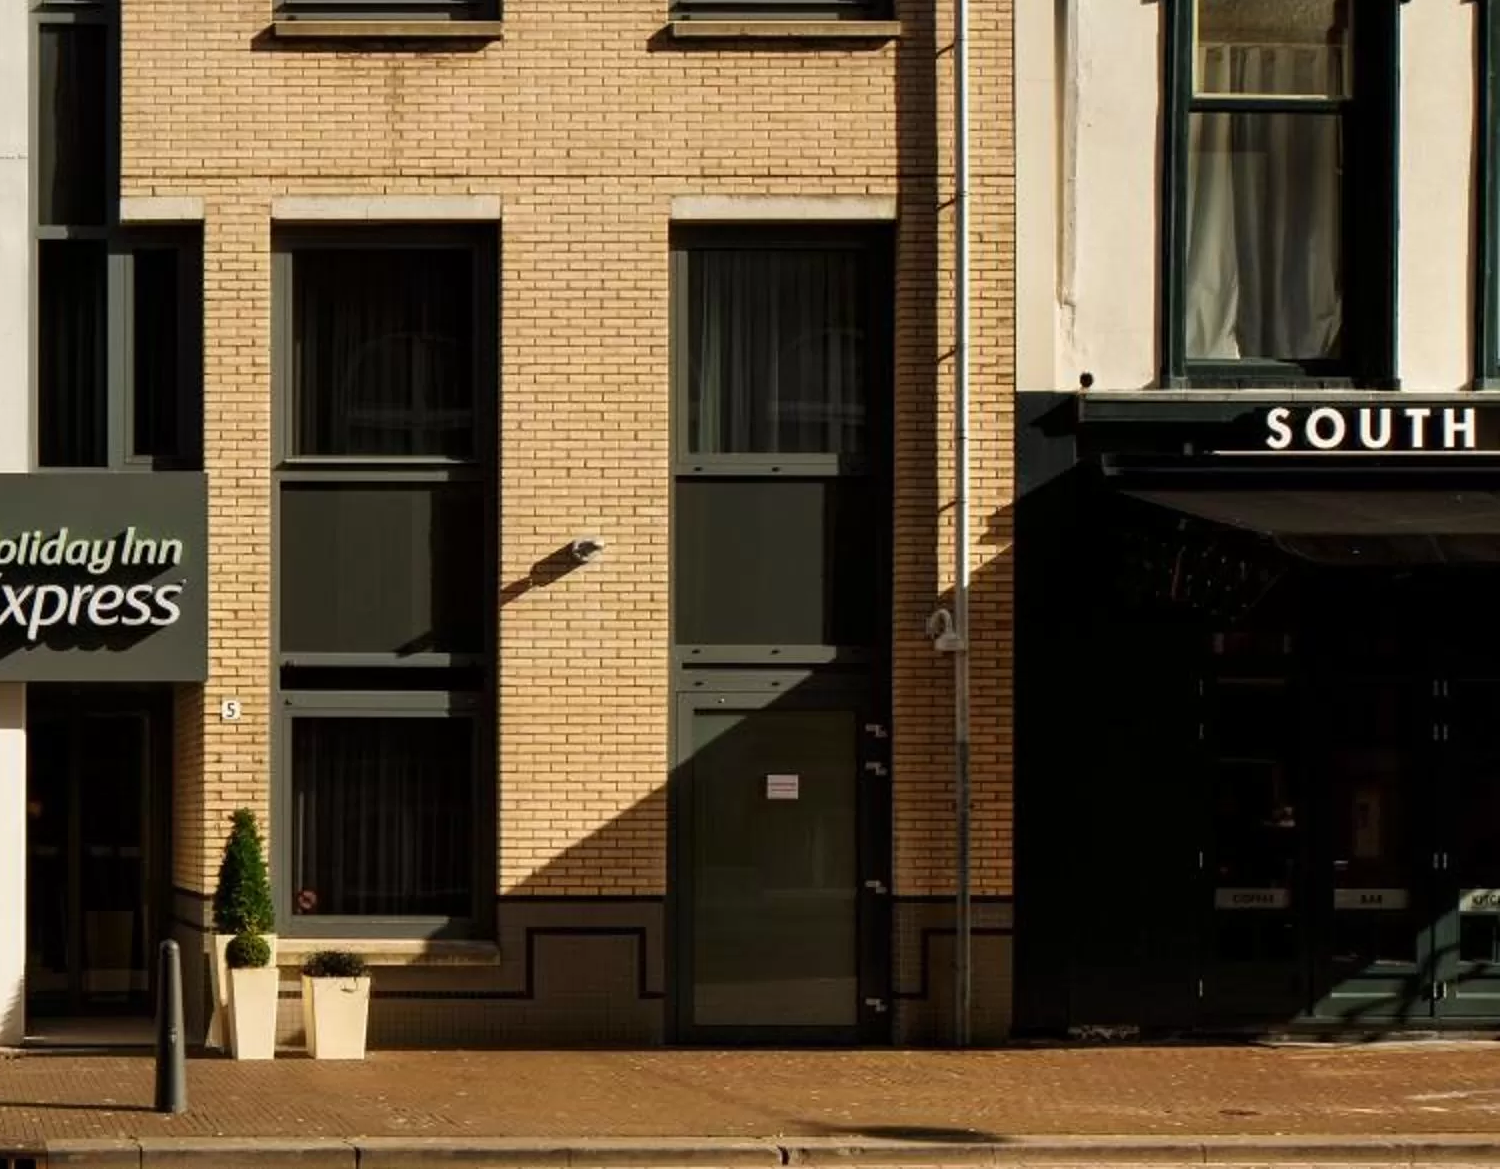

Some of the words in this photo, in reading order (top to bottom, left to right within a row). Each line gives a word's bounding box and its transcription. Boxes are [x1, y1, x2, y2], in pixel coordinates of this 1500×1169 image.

[1265, 407, 1476, 450] SOUTH
[120, 526, 183, 566] Inn
[226, 702, 236, 718] 5
